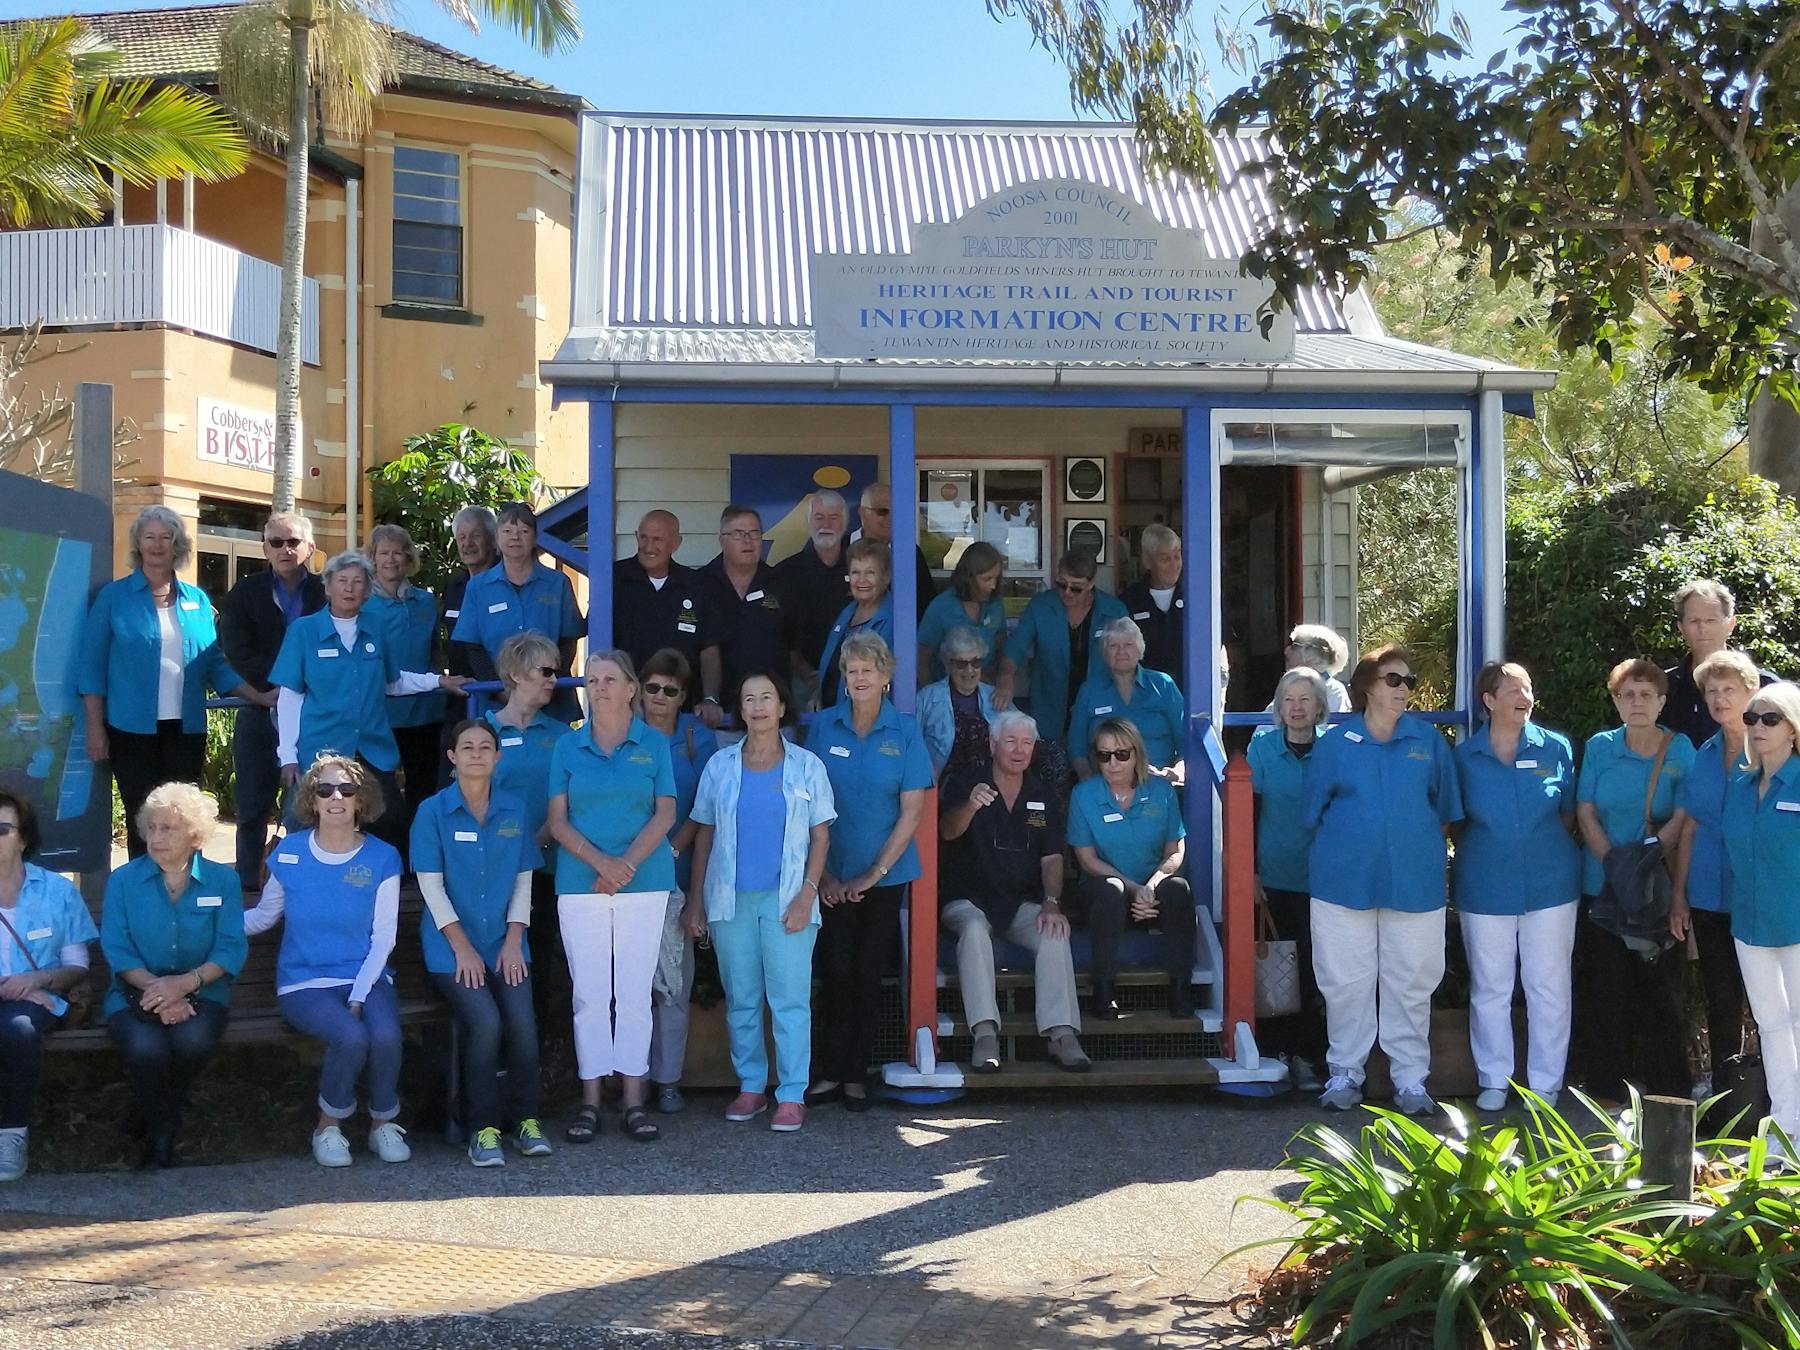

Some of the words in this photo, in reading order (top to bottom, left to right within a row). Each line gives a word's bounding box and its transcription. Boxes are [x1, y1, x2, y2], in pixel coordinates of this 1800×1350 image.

[985, 189, 1047, 223] NOOSA
[1055, 187, 1136, 226] COUNCIL
[1044, 211, 1078, 225] 2001
[962, 235, 1094, 260] PARKYN'S
[1100, 238, 1158, 261] HUT
[839, 265, 856, 275] AN
[860, 265, 887, 275] OLD
[889, 265, 938, 276] GYMPIE
[943, 266, 1021, 276] GOLDFIELDS
[1025, 266, 1074, 277] MINERS
[1078, 267, 1104, 277] HUT
[1108, 268, 1164, 278] BROUGHT
[1169, 268, 1185, 278] TO
[1189, 269, 1253, 280] TEWANT
[879, 284, 996, 299] HERITAGE
[1003, 285, 1077, 300] TRAIL
[1085, 286, 1134, 301] AND
[1140, 287, 1238, 302] TOURIST
[860, 308, 1102, 331] INFORMATION
[1114, 311, 1253, 333] CENTRE
[884, 337, 960, 348] TEWANTIN
[965, 337, 1035, 349] HERITAGE
[1043, 338, 1075, 350] AND
[1079, 339, 1162, 350] HISTORICAL
[1166, 340, 1229, 352] SOCIETY
[206, 427, 276, 466] BISTR
[1141, 432, 1180, 453] PAR
